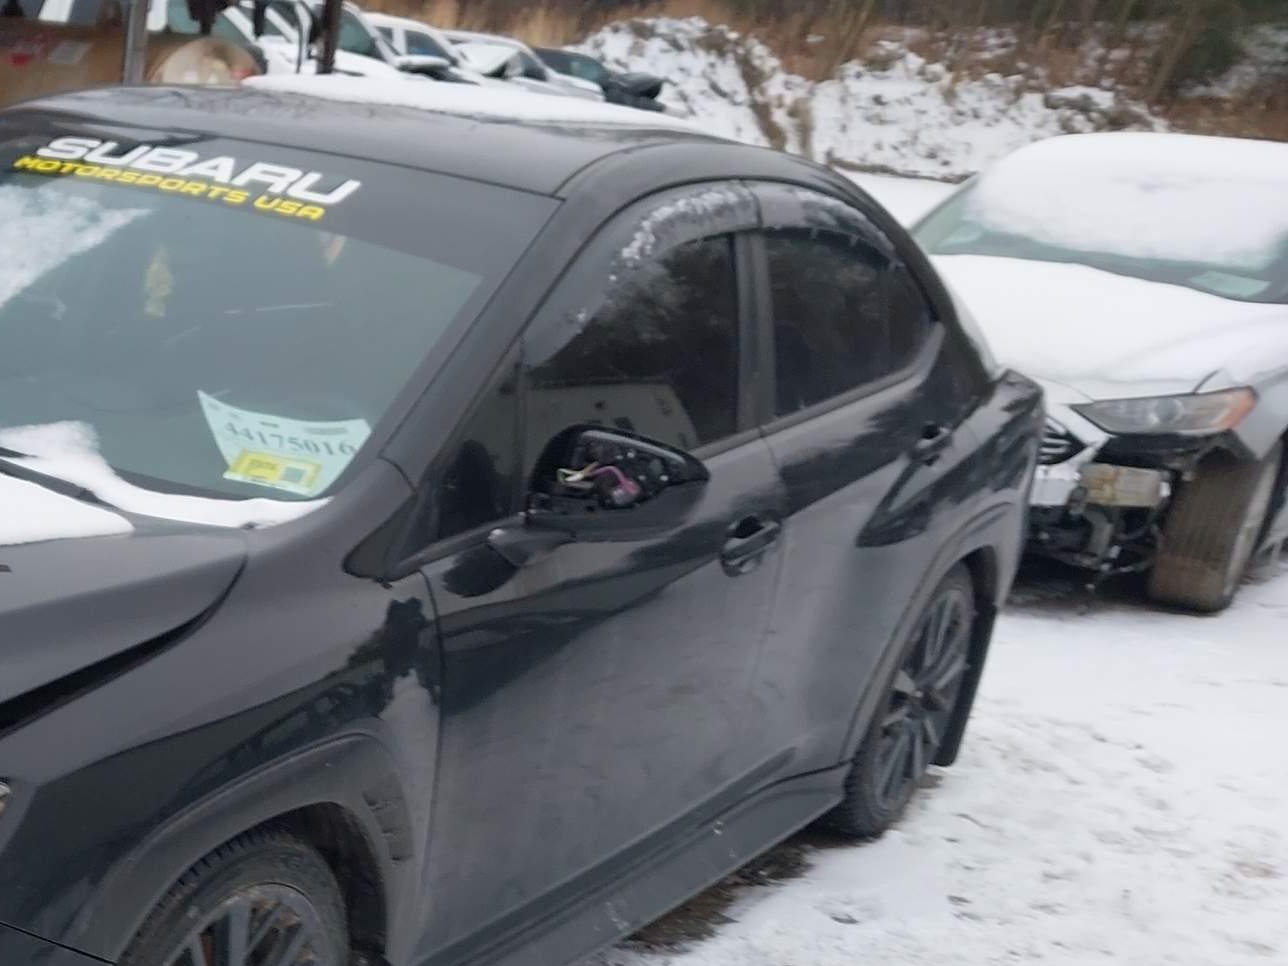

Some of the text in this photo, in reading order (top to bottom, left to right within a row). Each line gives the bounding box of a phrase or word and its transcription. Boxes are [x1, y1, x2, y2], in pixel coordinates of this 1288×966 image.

[14, 154, 327, 221] MOTORSPORTS USA
[36, 136, 361, 206] SUBARU
[223, 420, 356, 457] 44175016
